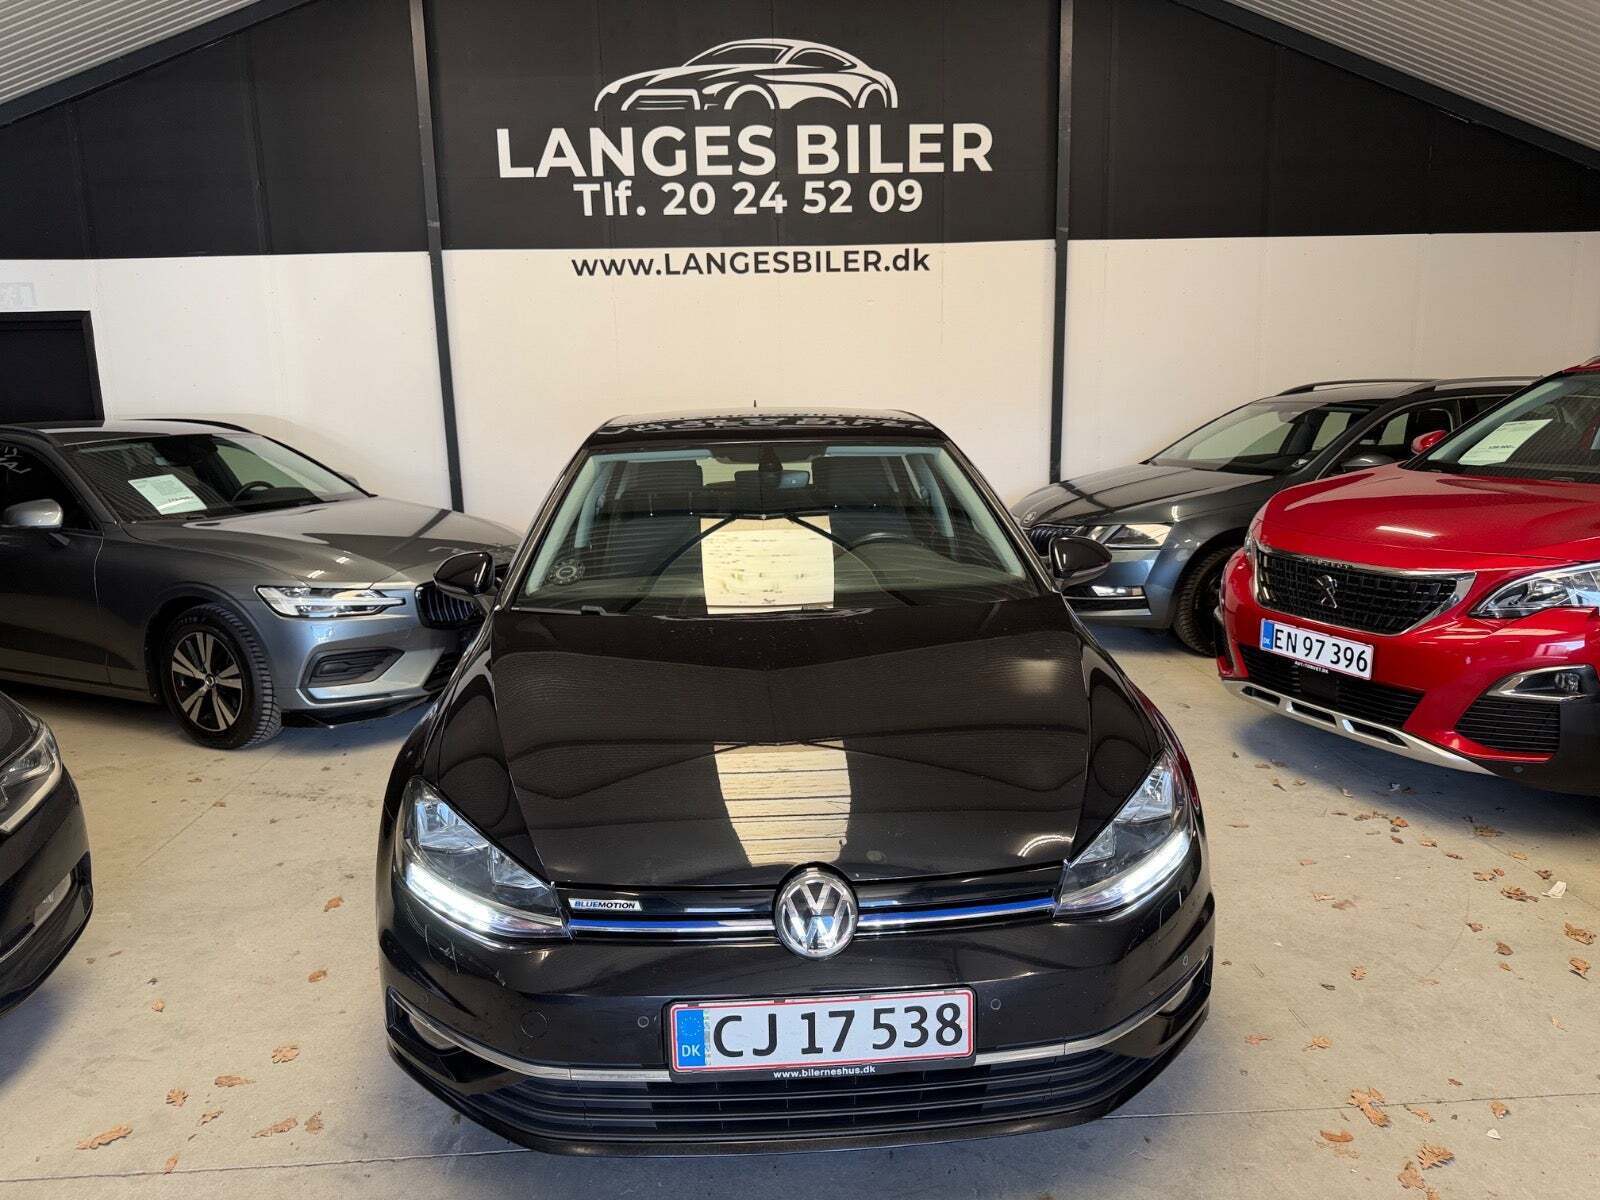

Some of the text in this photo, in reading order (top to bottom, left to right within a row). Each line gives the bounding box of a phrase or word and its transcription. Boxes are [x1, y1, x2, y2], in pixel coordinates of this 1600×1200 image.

[496, 123, 994, 178] LANGES BILER
[573, 179, 924, 217] Tlf. 20 24 52 09
[571, 248, 931, 277] www.LANGESBILER.dk
[1274, 629, 1298, 654] EN
[1303, 636, 1326, 660] 97
[1330, 643, 1368, 673] 396
[574, 900, 636, 909] BLUEMOTION
[713, 1002, 963, 1058] CJ 17 538
[681, 1044, 701, 1058] DK
[773, 1065, 876, 1079] www.bilerneshus.dk
